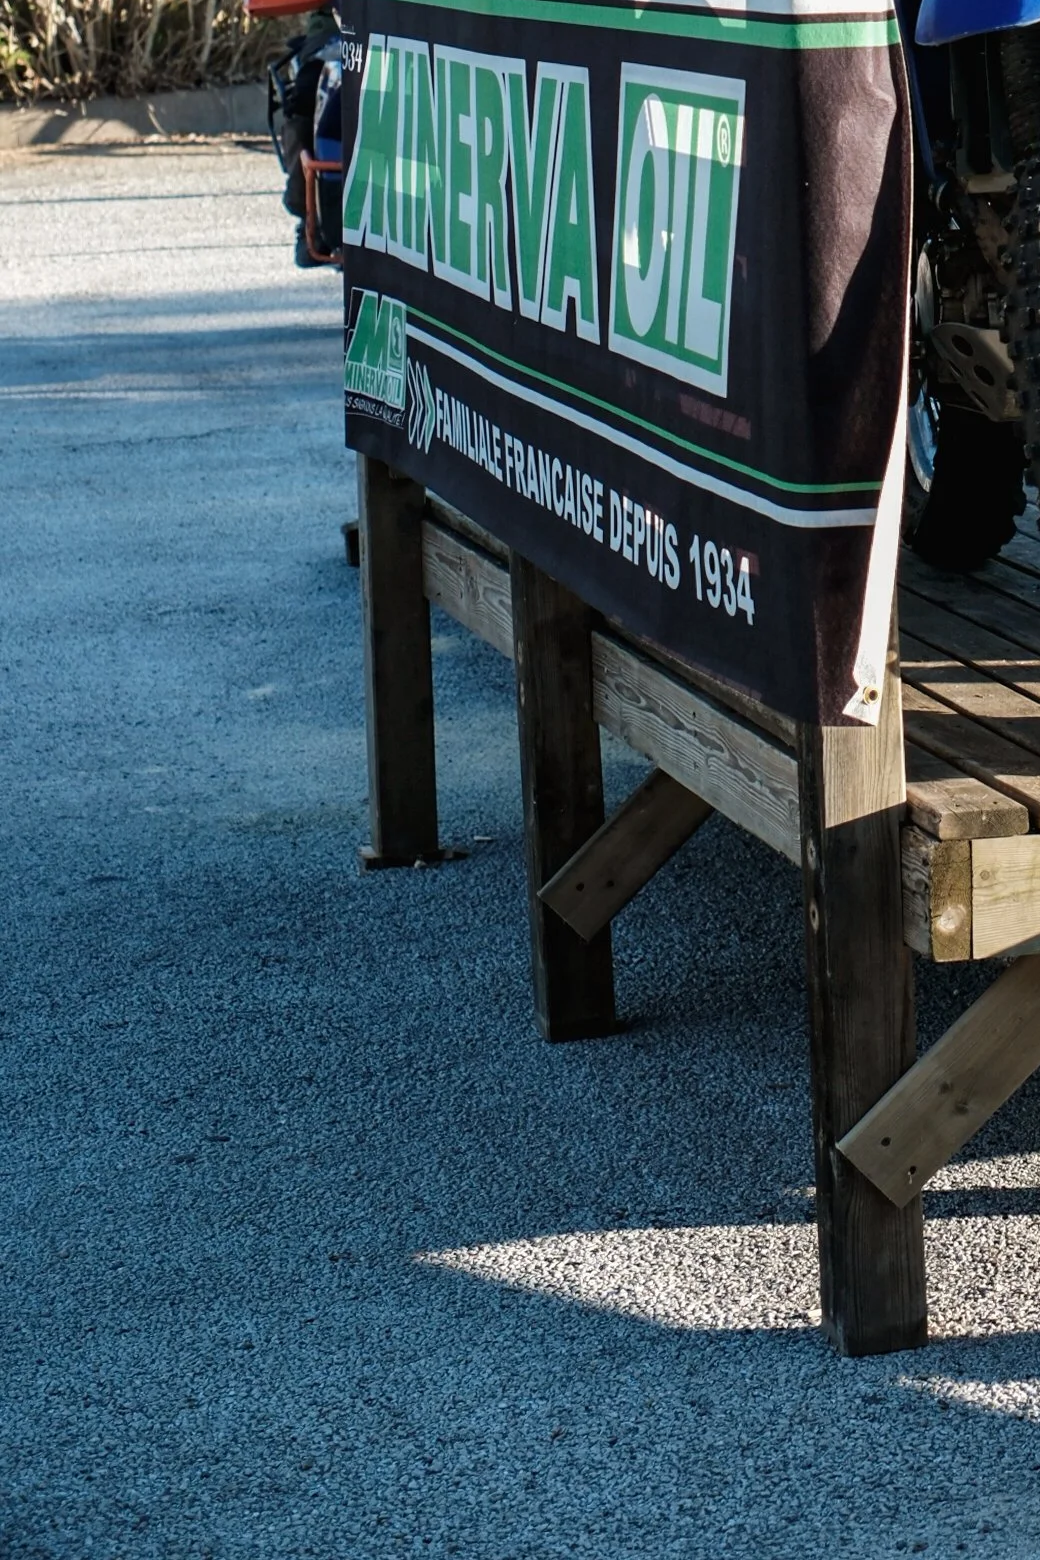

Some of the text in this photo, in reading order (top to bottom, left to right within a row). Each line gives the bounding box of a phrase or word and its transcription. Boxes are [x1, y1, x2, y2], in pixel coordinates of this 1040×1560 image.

[341, 40, 363, 73] 934
[343, 33, 600, 345] MINERVA
[435, 387, 756, 626] FAMILIALE FRANCAISE DEPUIS 1934
